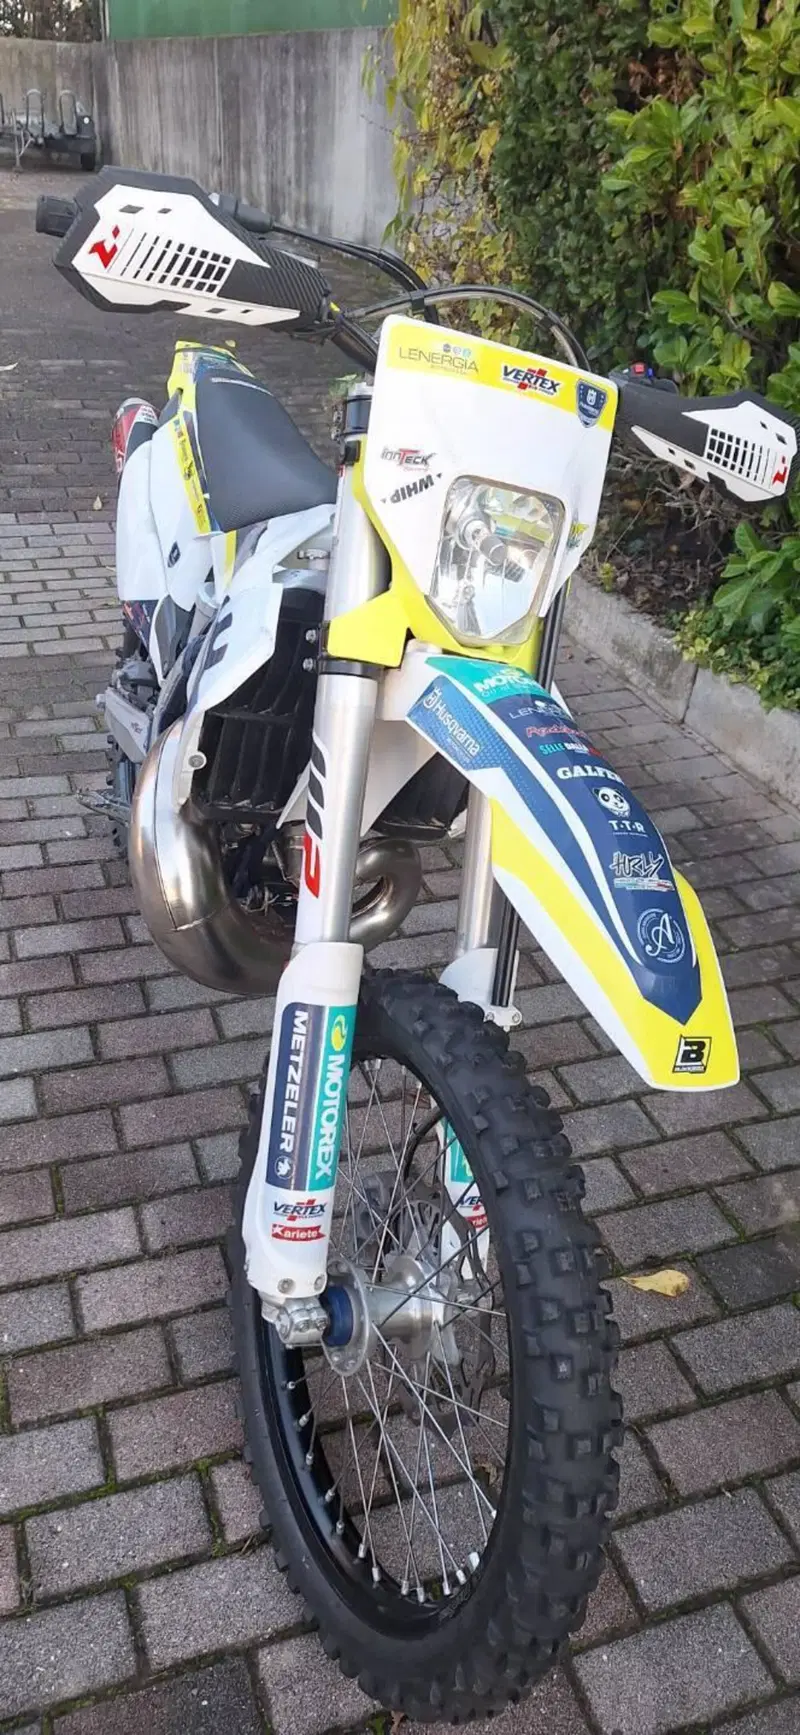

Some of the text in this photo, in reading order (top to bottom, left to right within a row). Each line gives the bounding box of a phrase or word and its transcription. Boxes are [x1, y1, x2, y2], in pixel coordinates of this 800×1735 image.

[399, 346, 479, 373] LENERGIA
[503, 365, 561, 394] VERTEX
[432, 699, 480, 757] Husqvarna
[539, 743, 566, 755] SELLE
[279, 1010, 310, 1152] METZELER
[314, 1053, 346, 1179] MOTOREX
[274, 1201, 328, 1215] VERTEX
[283, 1229, 318, 1240] ariete
